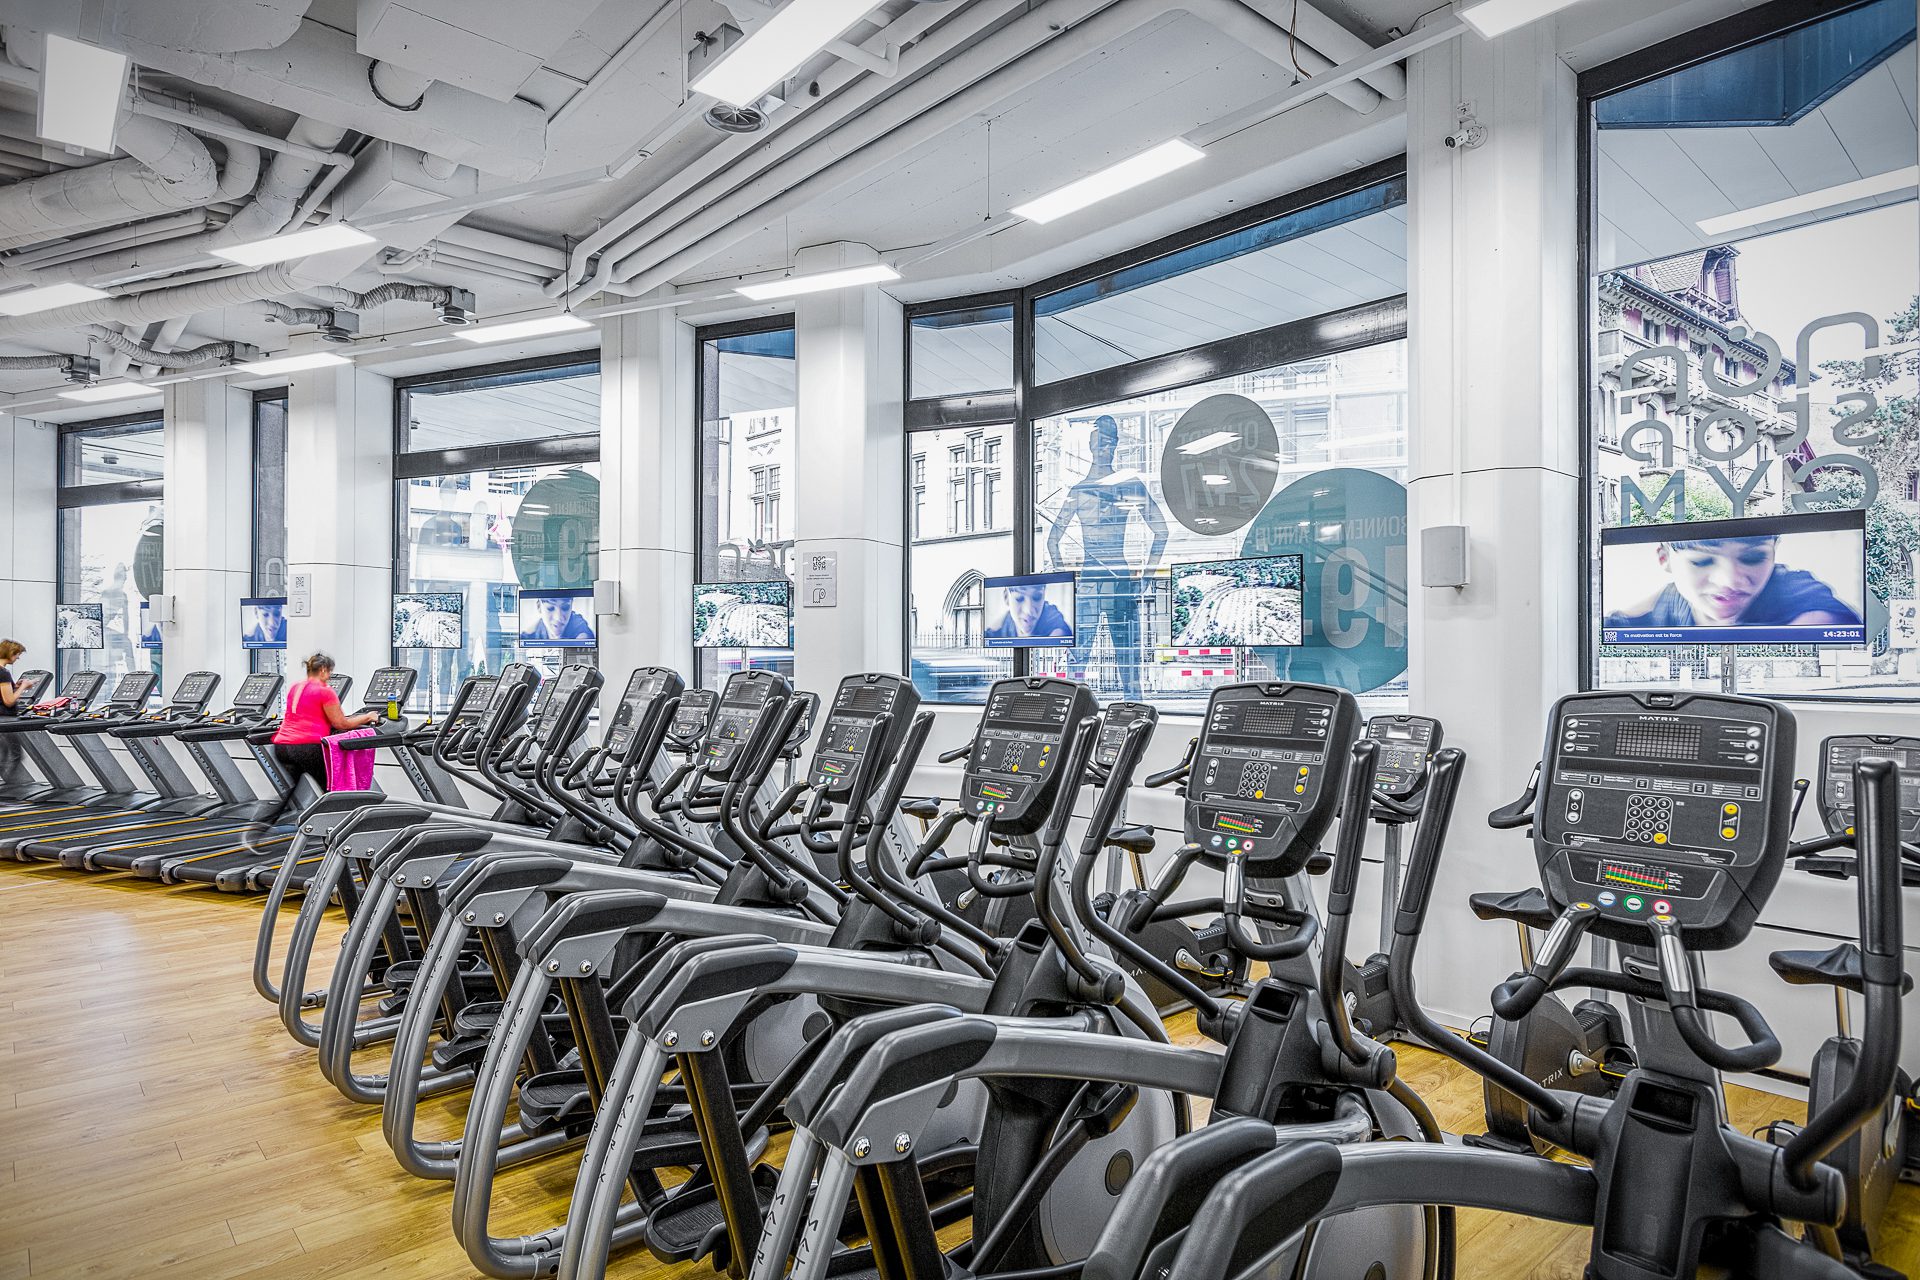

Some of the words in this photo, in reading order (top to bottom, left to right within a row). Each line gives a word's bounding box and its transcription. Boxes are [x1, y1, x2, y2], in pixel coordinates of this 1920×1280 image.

[1822, 630, 1861, 638] 14:23:01
[398, 746, 431, 795] MATRIX
[887, 823, 925, 897] MATIX
